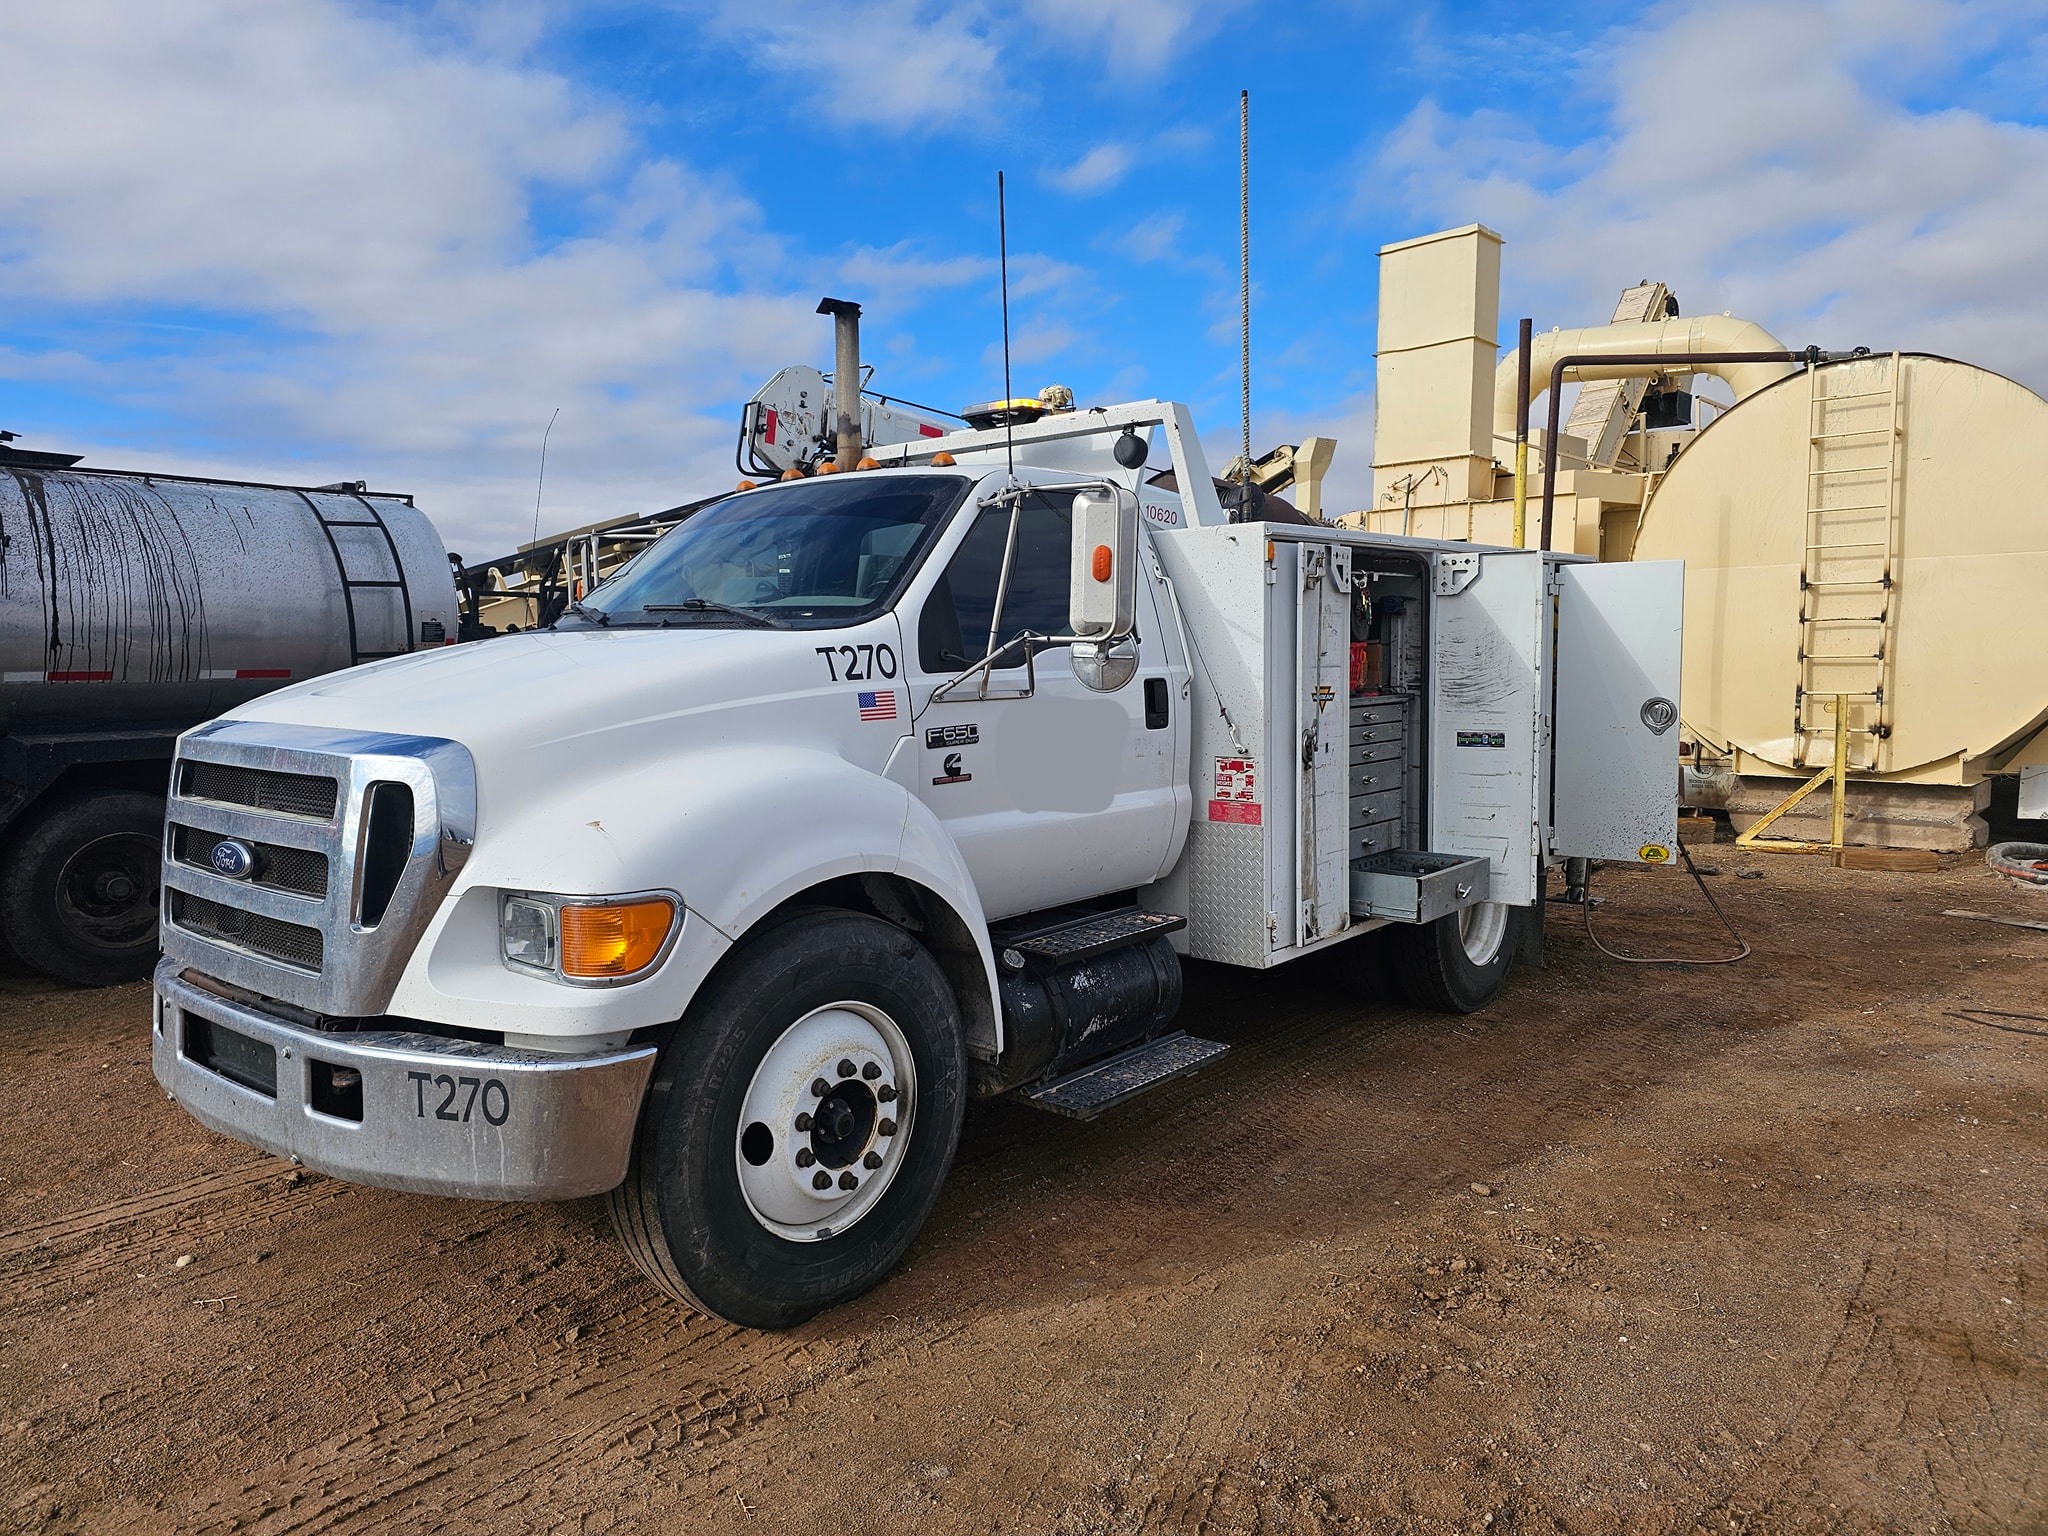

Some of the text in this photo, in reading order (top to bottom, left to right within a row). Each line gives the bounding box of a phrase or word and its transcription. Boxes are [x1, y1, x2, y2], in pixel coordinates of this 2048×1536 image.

[1146, 505, 1177, 525] 10620
[815, 643, 897, 681] T270
[215, 847, 236, 870] Ford
[408, 1071, 510, 1126] T270
